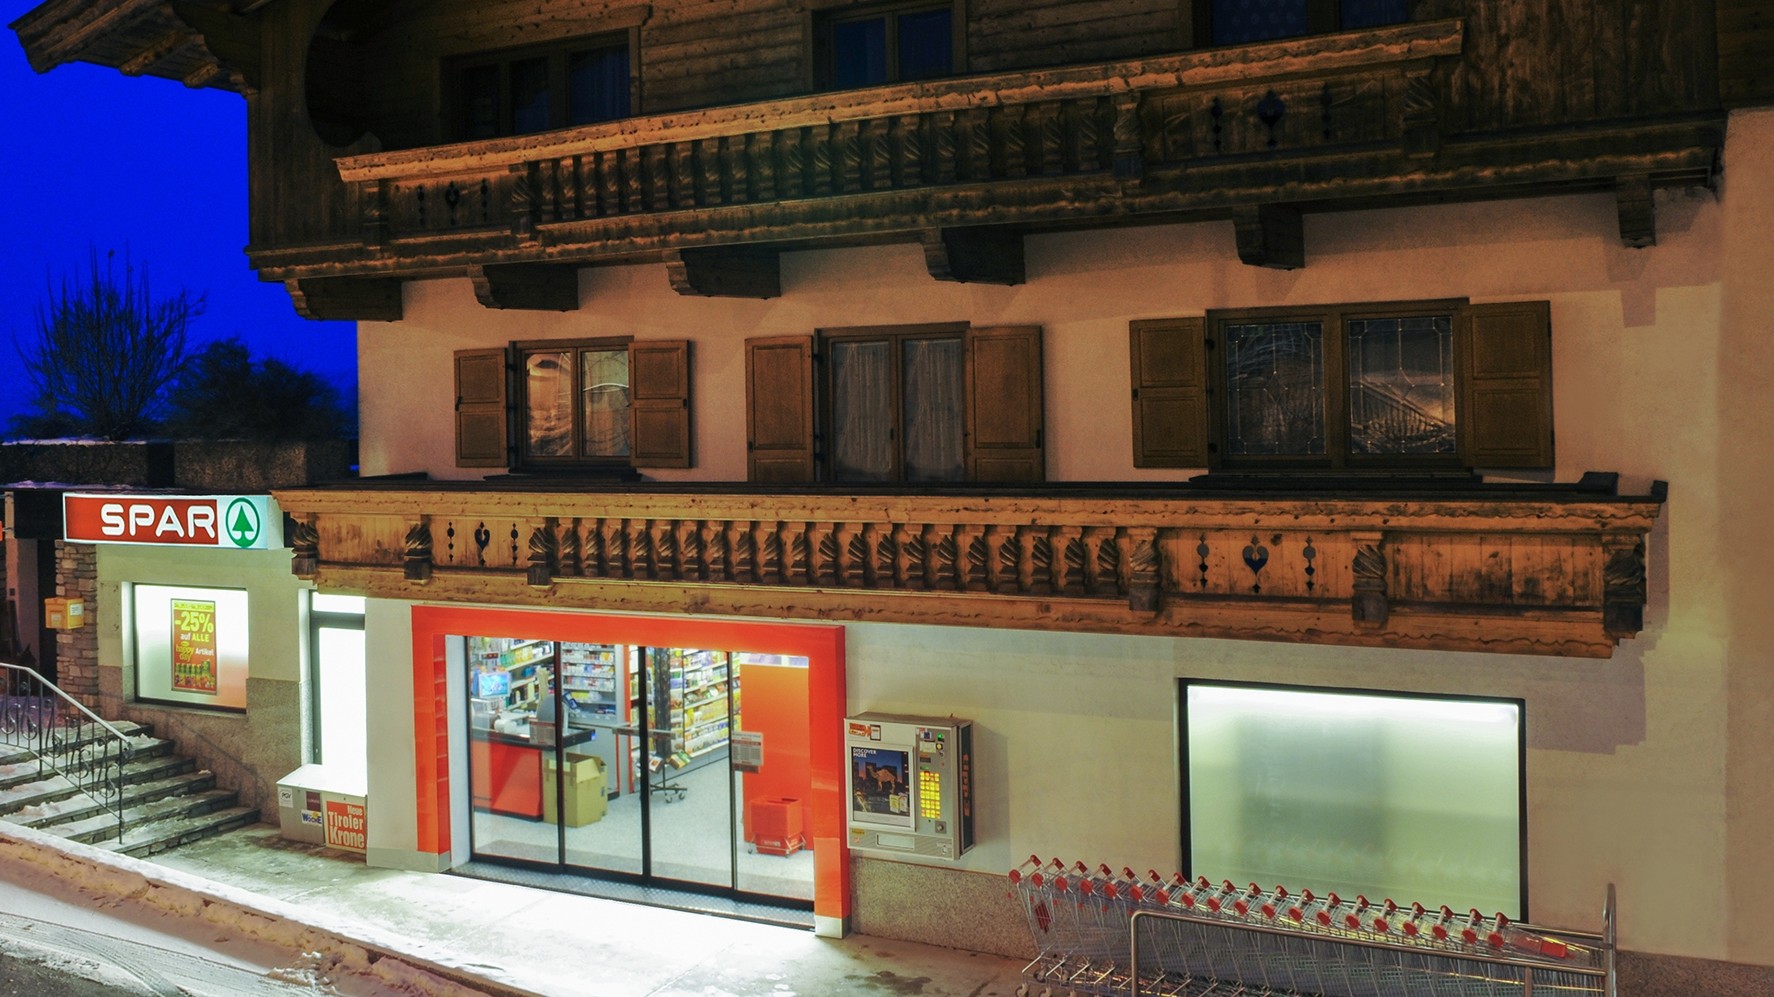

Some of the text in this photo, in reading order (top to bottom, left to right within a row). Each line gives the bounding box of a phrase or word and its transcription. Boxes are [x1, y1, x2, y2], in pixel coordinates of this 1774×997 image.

[101, 503, 215, 538] SPAR
[175, 611, 214, 634] -25%
[192, 633, 210, 642] ALLE
[176, 644, 195, 656] happy
[195, 648, 214, 656] Artikel
[347, 805, 363, 816] Neue
[328, 811, 364, 830] Tiroler
[329, 827, 365, 848] Krone
